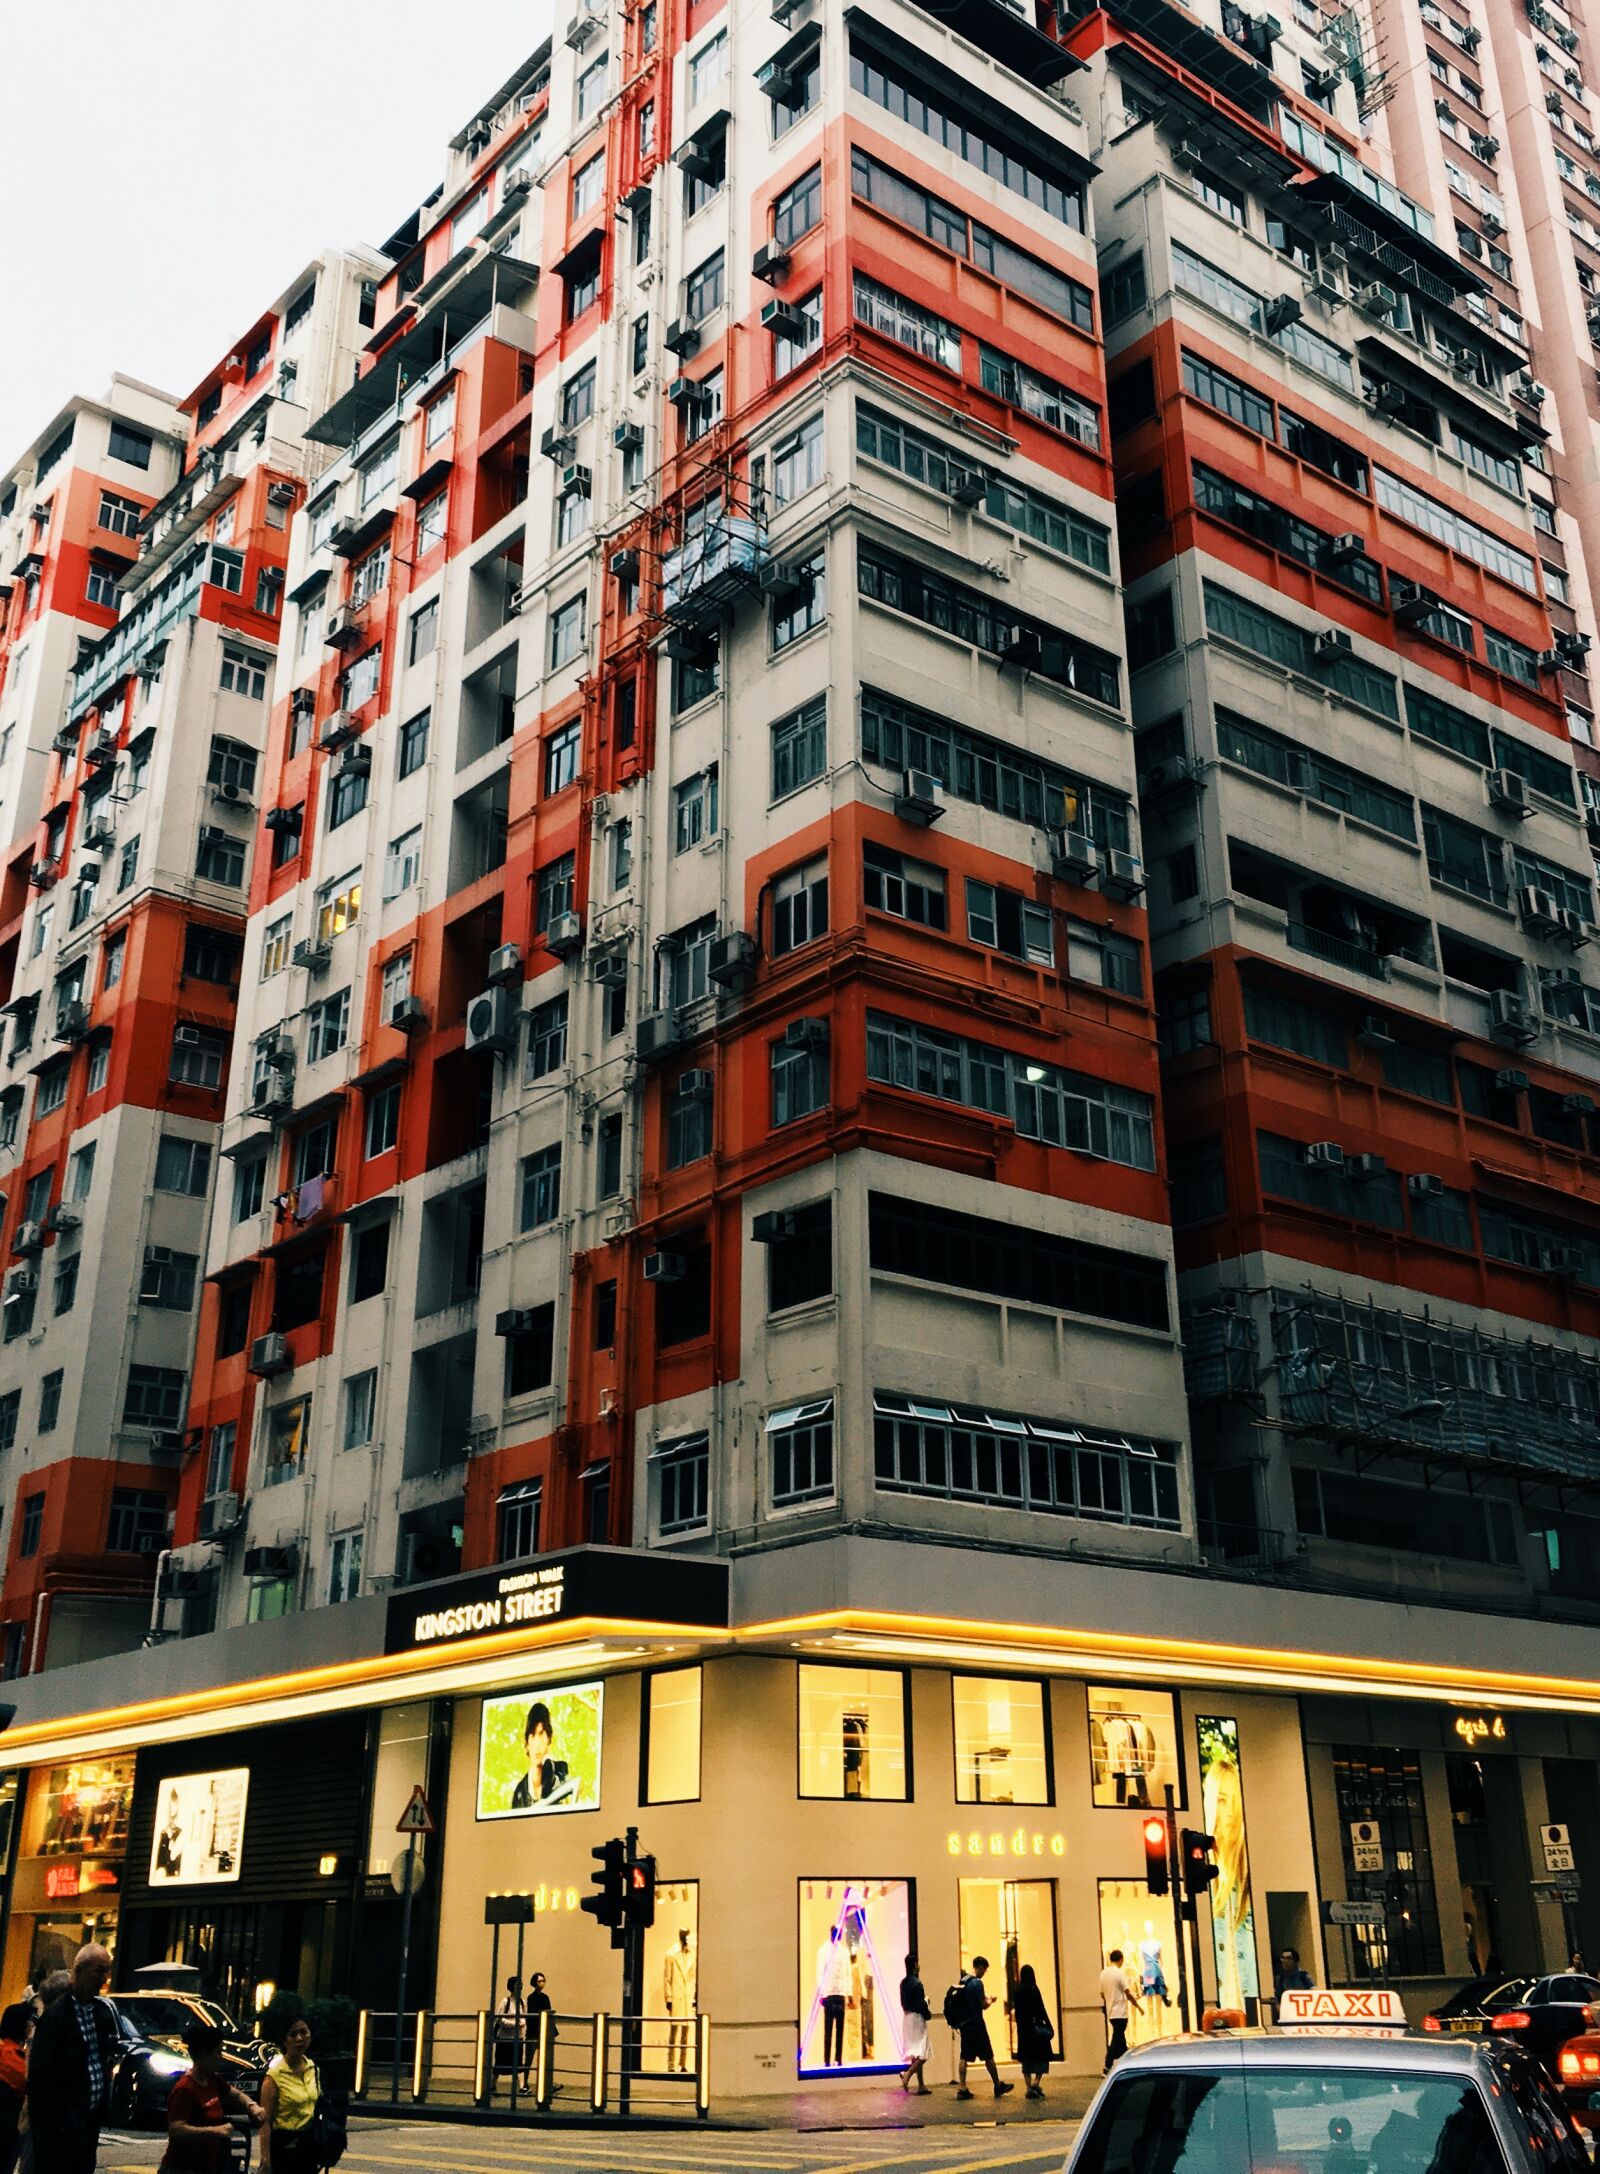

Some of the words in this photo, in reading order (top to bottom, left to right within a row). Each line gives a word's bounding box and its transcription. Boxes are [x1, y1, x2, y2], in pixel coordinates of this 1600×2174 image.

[499, 1572, 538, 1593] FASHION
[538, 1566, 564, 1584] WALK
[415, 1600, 501, 1641] KINGSTON
[504, 1585, 564, 1624] STREET
[946, 1827, 1066, 1857] sandro
[1289, 1994, 1391, 2017] TAXI
